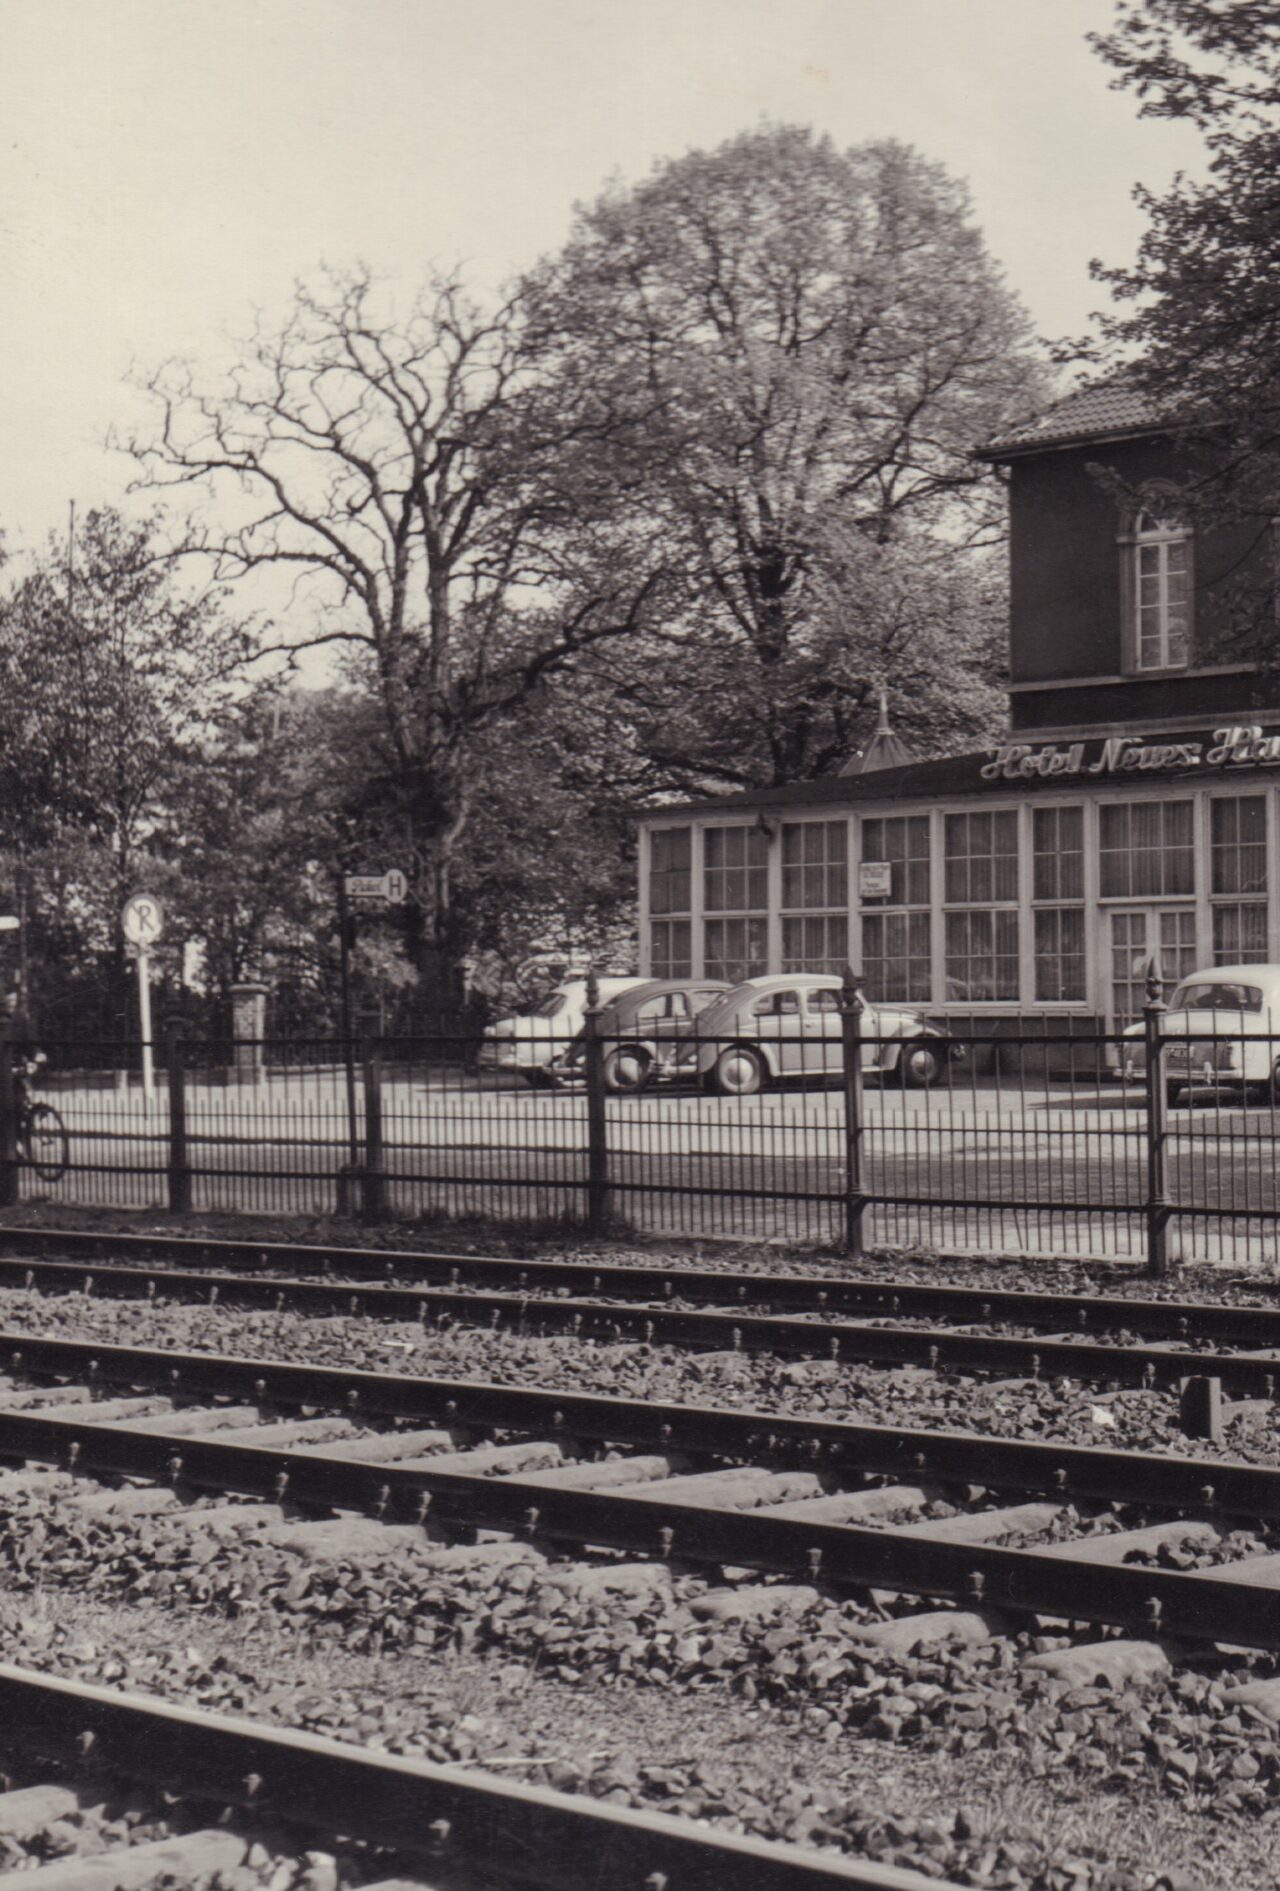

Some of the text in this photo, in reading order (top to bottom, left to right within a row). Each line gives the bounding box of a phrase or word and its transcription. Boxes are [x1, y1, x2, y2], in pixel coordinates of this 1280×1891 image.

[980, 743, 1085, 780] Hotel
[1088, 737, 1202, 773] Neues
[388, 875, 402, 897] H
